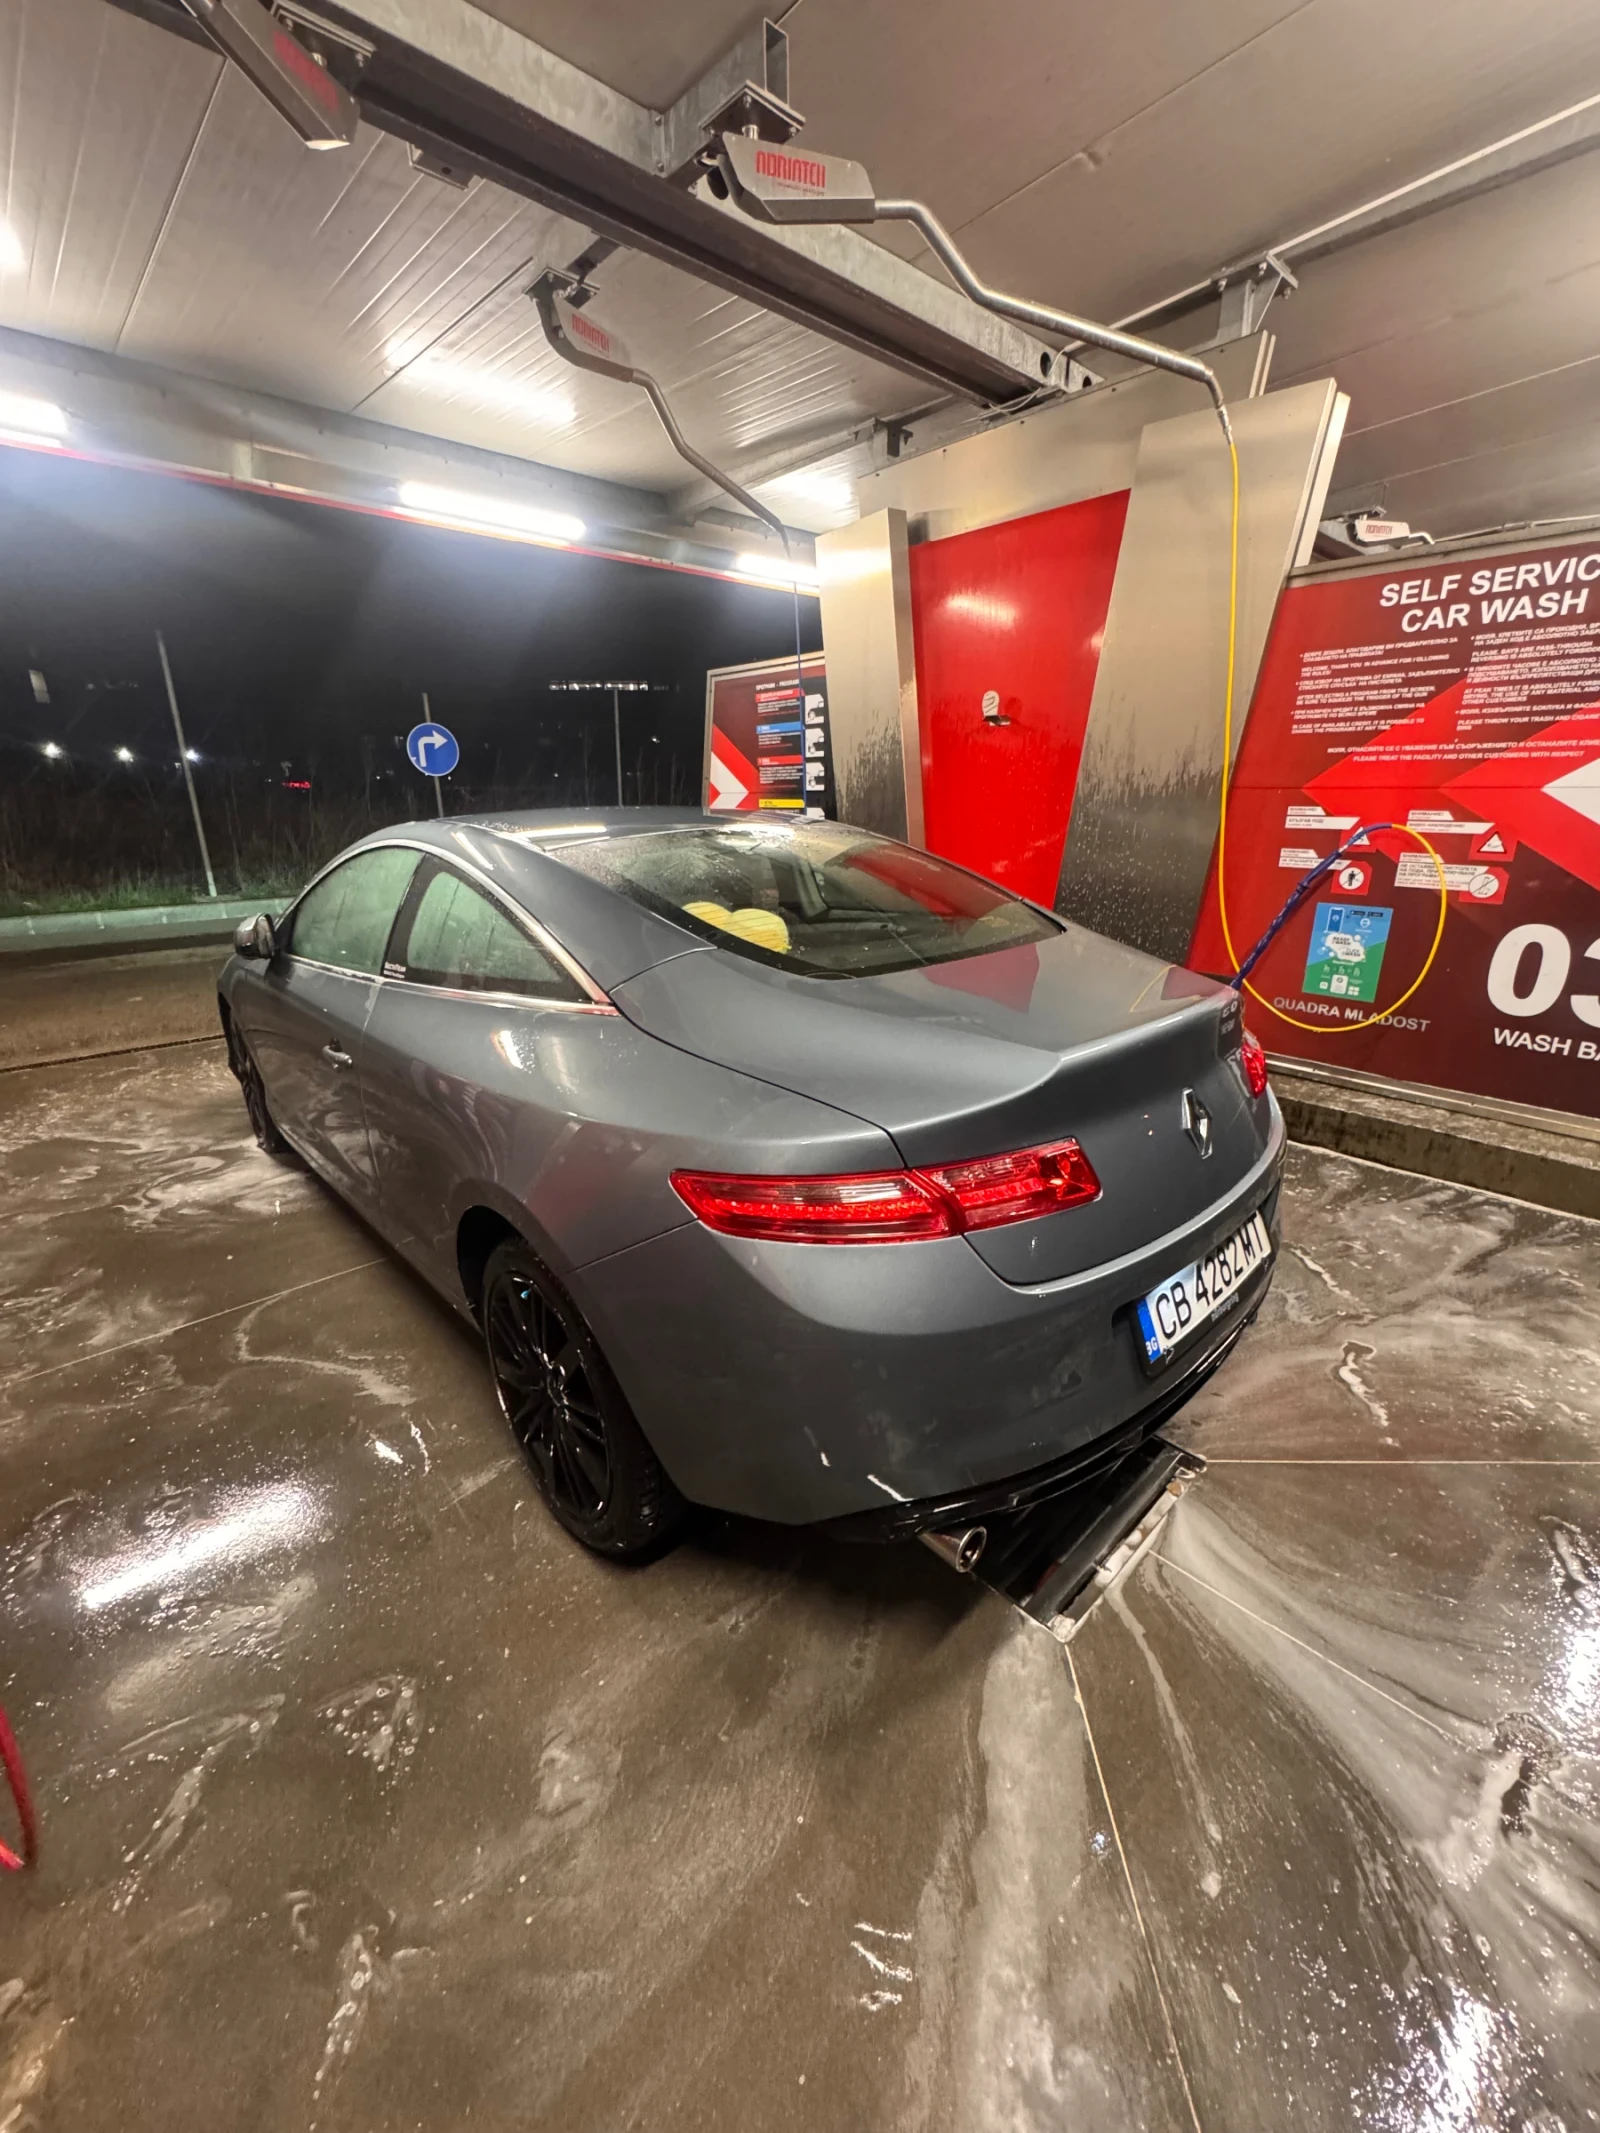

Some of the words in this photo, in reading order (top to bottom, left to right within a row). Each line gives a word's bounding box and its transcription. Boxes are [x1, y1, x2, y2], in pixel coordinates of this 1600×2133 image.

[1380, 574, 1462, 607] SELF
[1469, 553, 1600, 596] SERVIC
[1401, 603, 1470, 633] CAR
[1480, 588, 1590, 625] WASH
[1273, 997, 1340, 1018] QUADRA
[1344, 1008, 1431, 1032] MLADOST
[1494, 1027, 1572, 1056] WASH
[1155, 1280, 1192, 1340] CB
[1196, 1236, 1244, 1306] 4282
